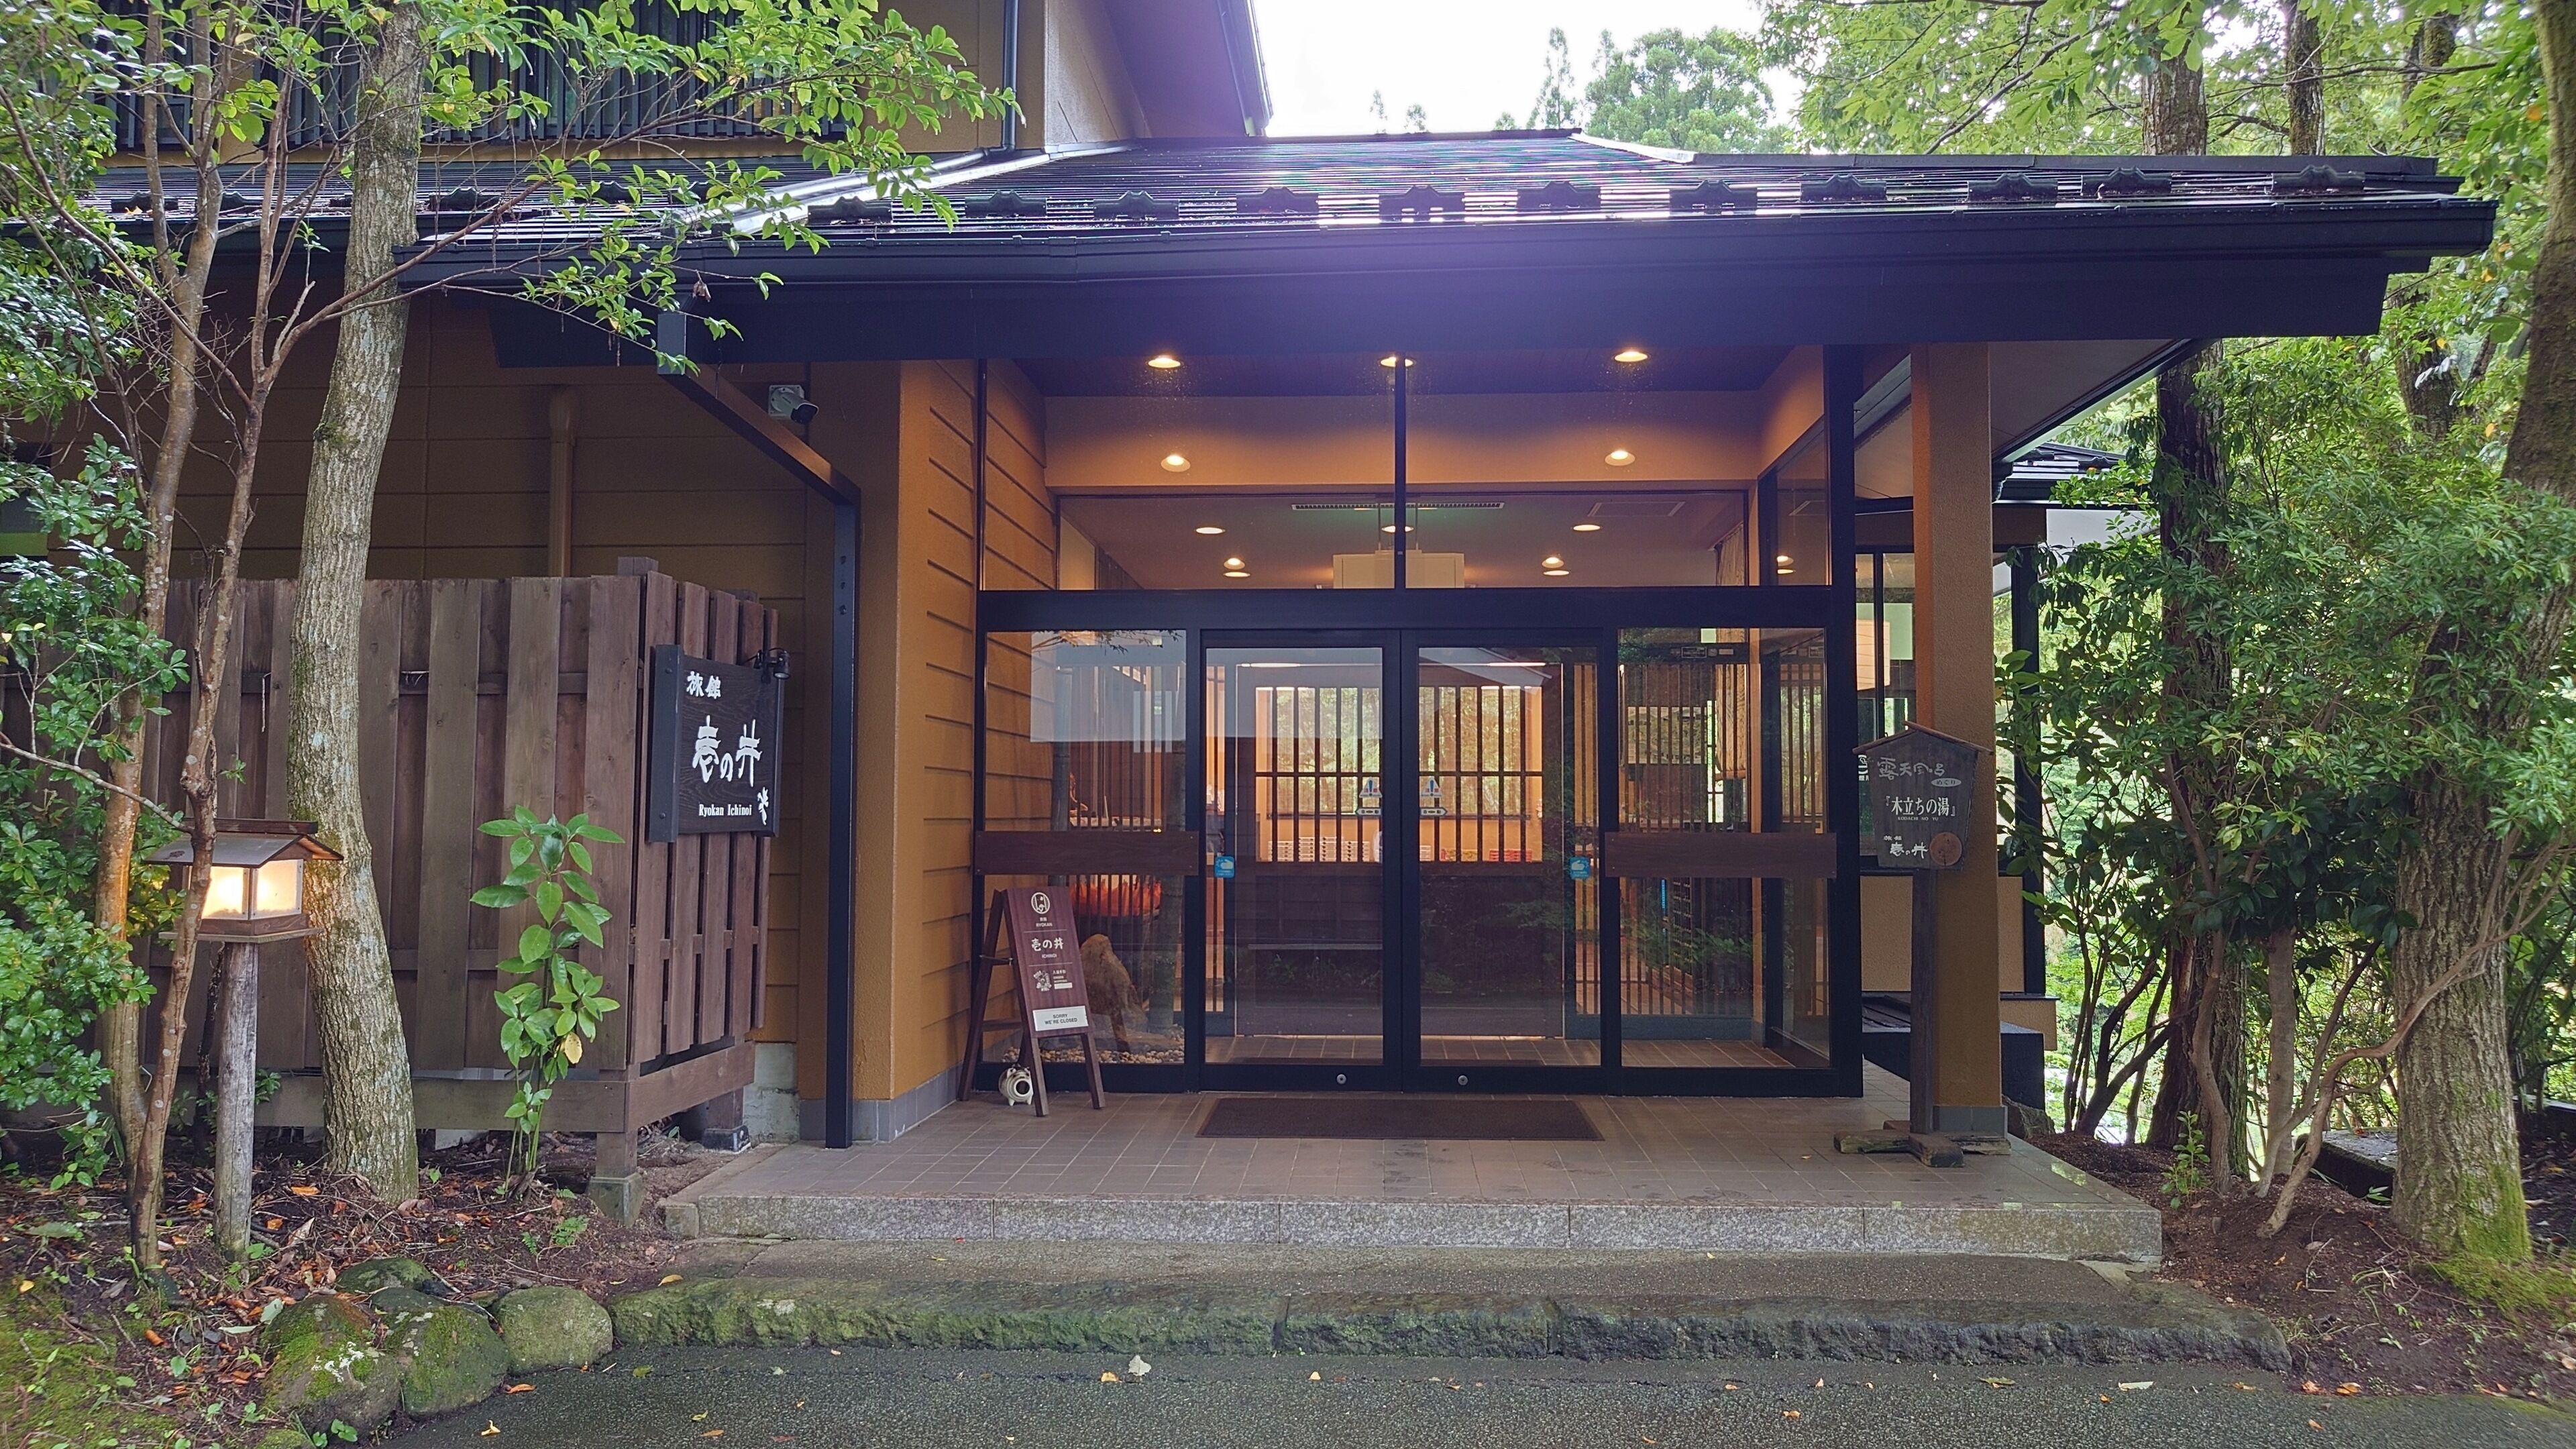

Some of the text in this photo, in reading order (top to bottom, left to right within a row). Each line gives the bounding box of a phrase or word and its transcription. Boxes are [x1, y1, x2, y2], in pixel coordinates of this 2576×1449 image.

[686, 671, 722, 699] 旅館
[698, 804, 752, 817] Ryokan Ichinoi
[1031, 936, 1064, 951] 壱の井
